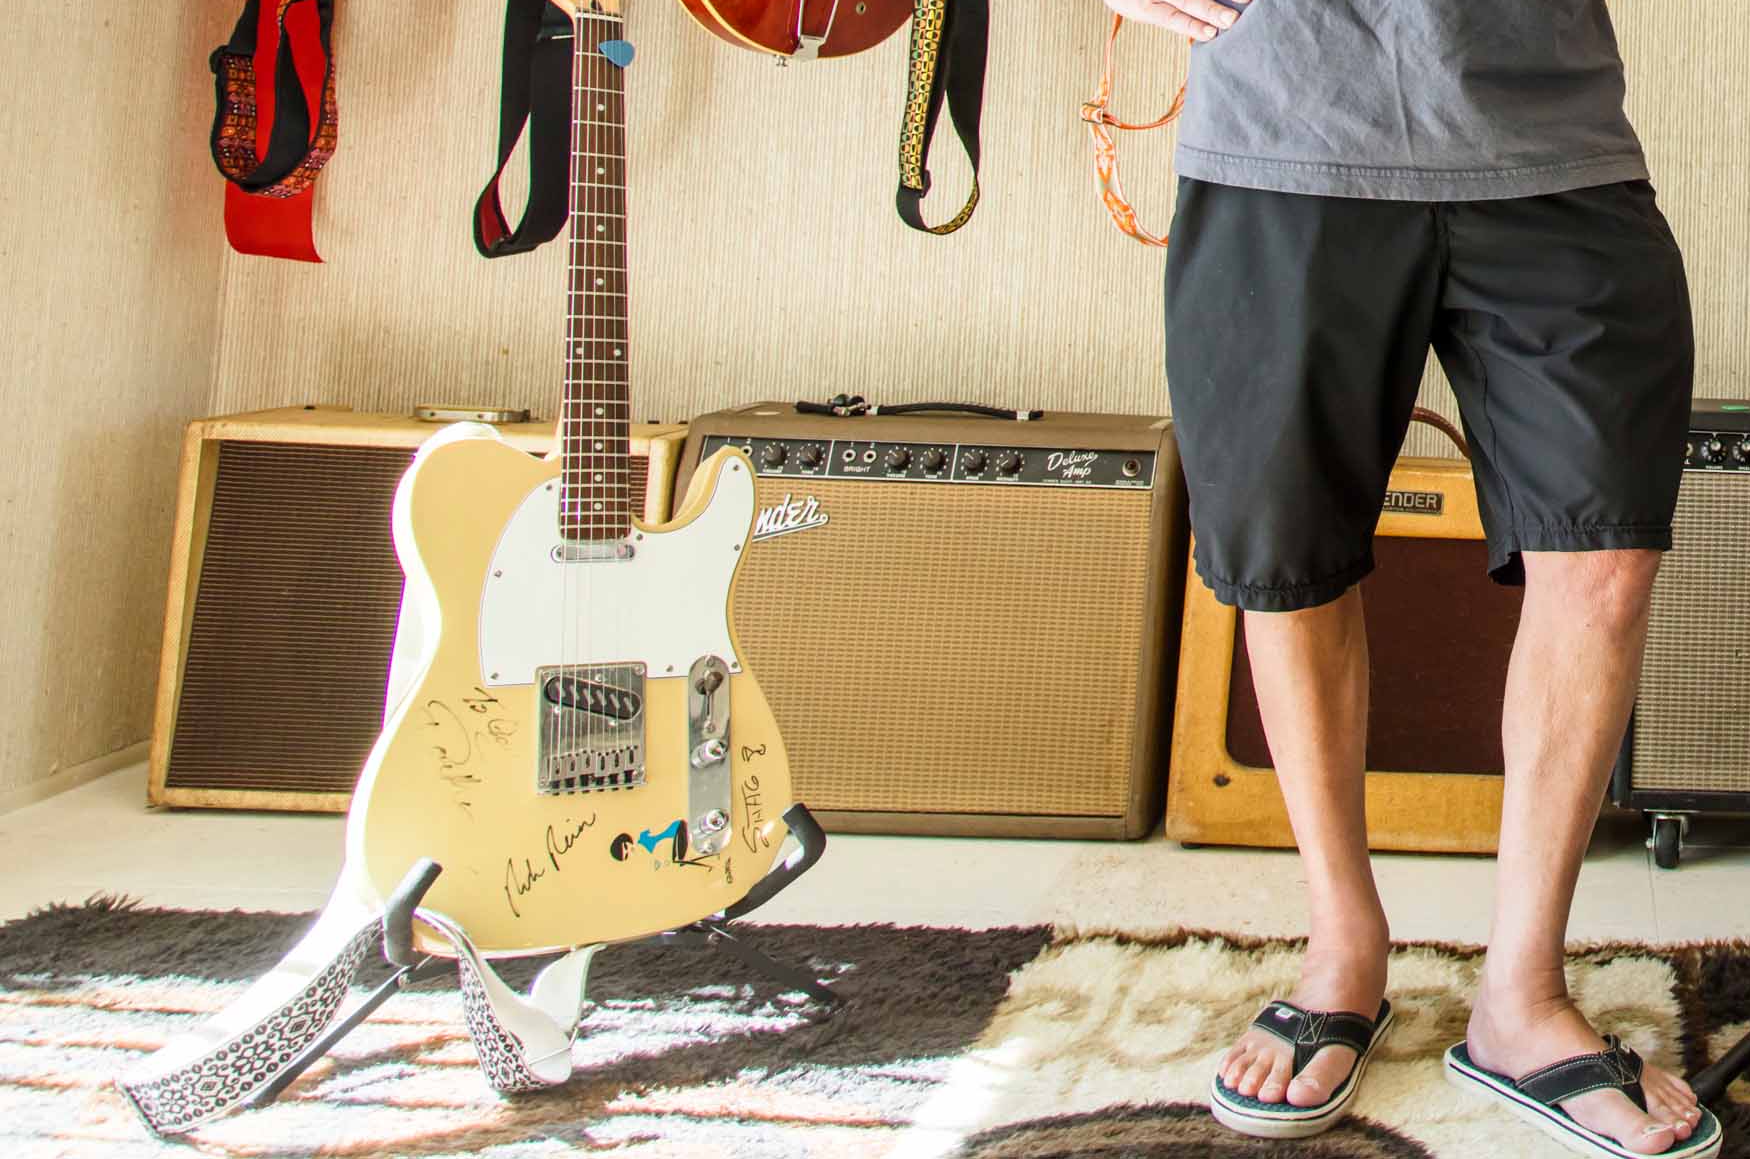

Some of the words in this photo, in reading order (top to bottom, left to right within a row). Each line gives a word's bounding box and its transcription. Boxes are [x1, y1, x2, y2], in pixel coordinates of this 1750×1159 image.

[843, 465, 871, 473] BRIGHT
[1047, 450, 1099, 471] Deluxe
[1061, 464, 1092, 479] Amp
[1383, 491, 1438, 509] ENDER
[753, 493, 830, 539] nder
